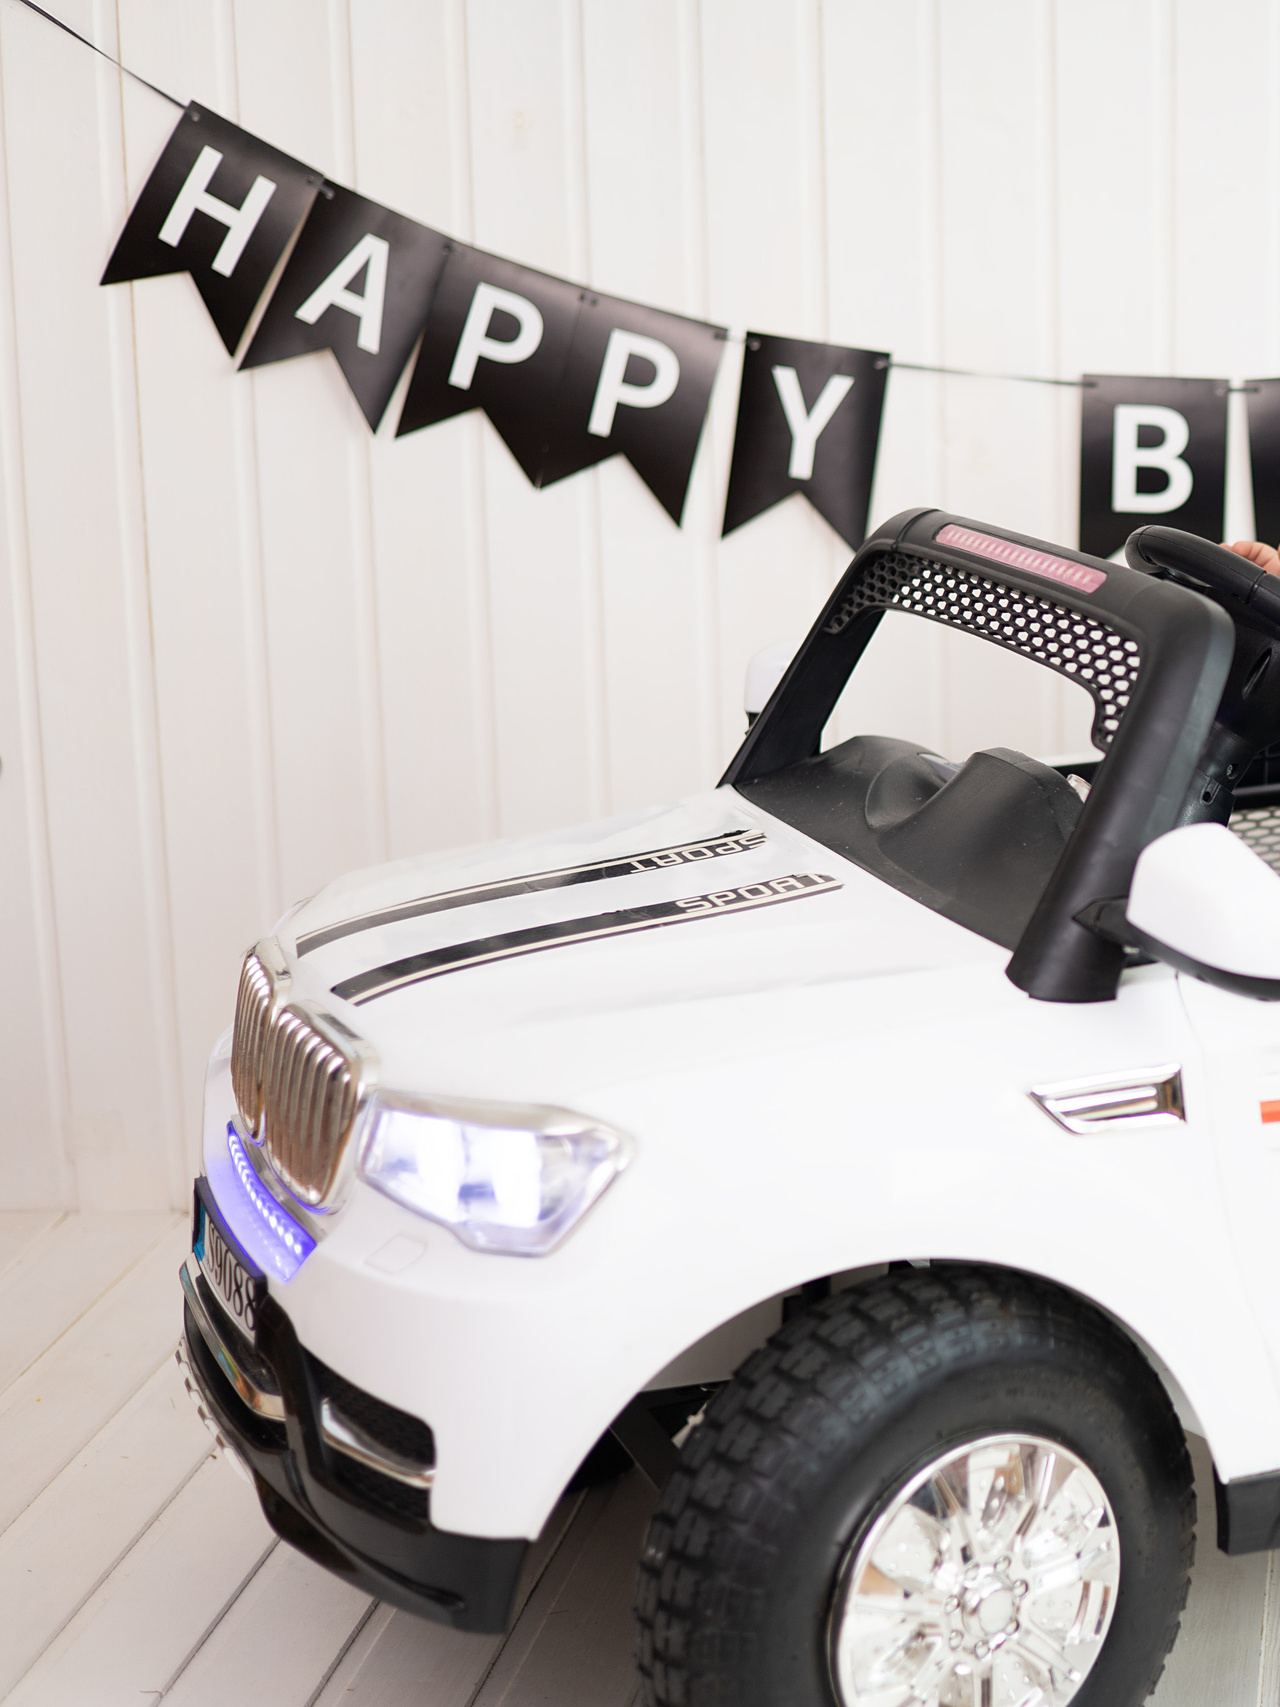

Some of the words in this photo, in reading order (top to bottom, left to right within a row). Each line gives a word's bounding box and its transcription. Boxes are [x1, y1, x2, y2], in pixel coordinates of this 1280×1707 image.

[157, 145, 856, 482] HAPPY
[630, 835, 768, 873] SPORT
[675, 873, 827, 914] SPORT
